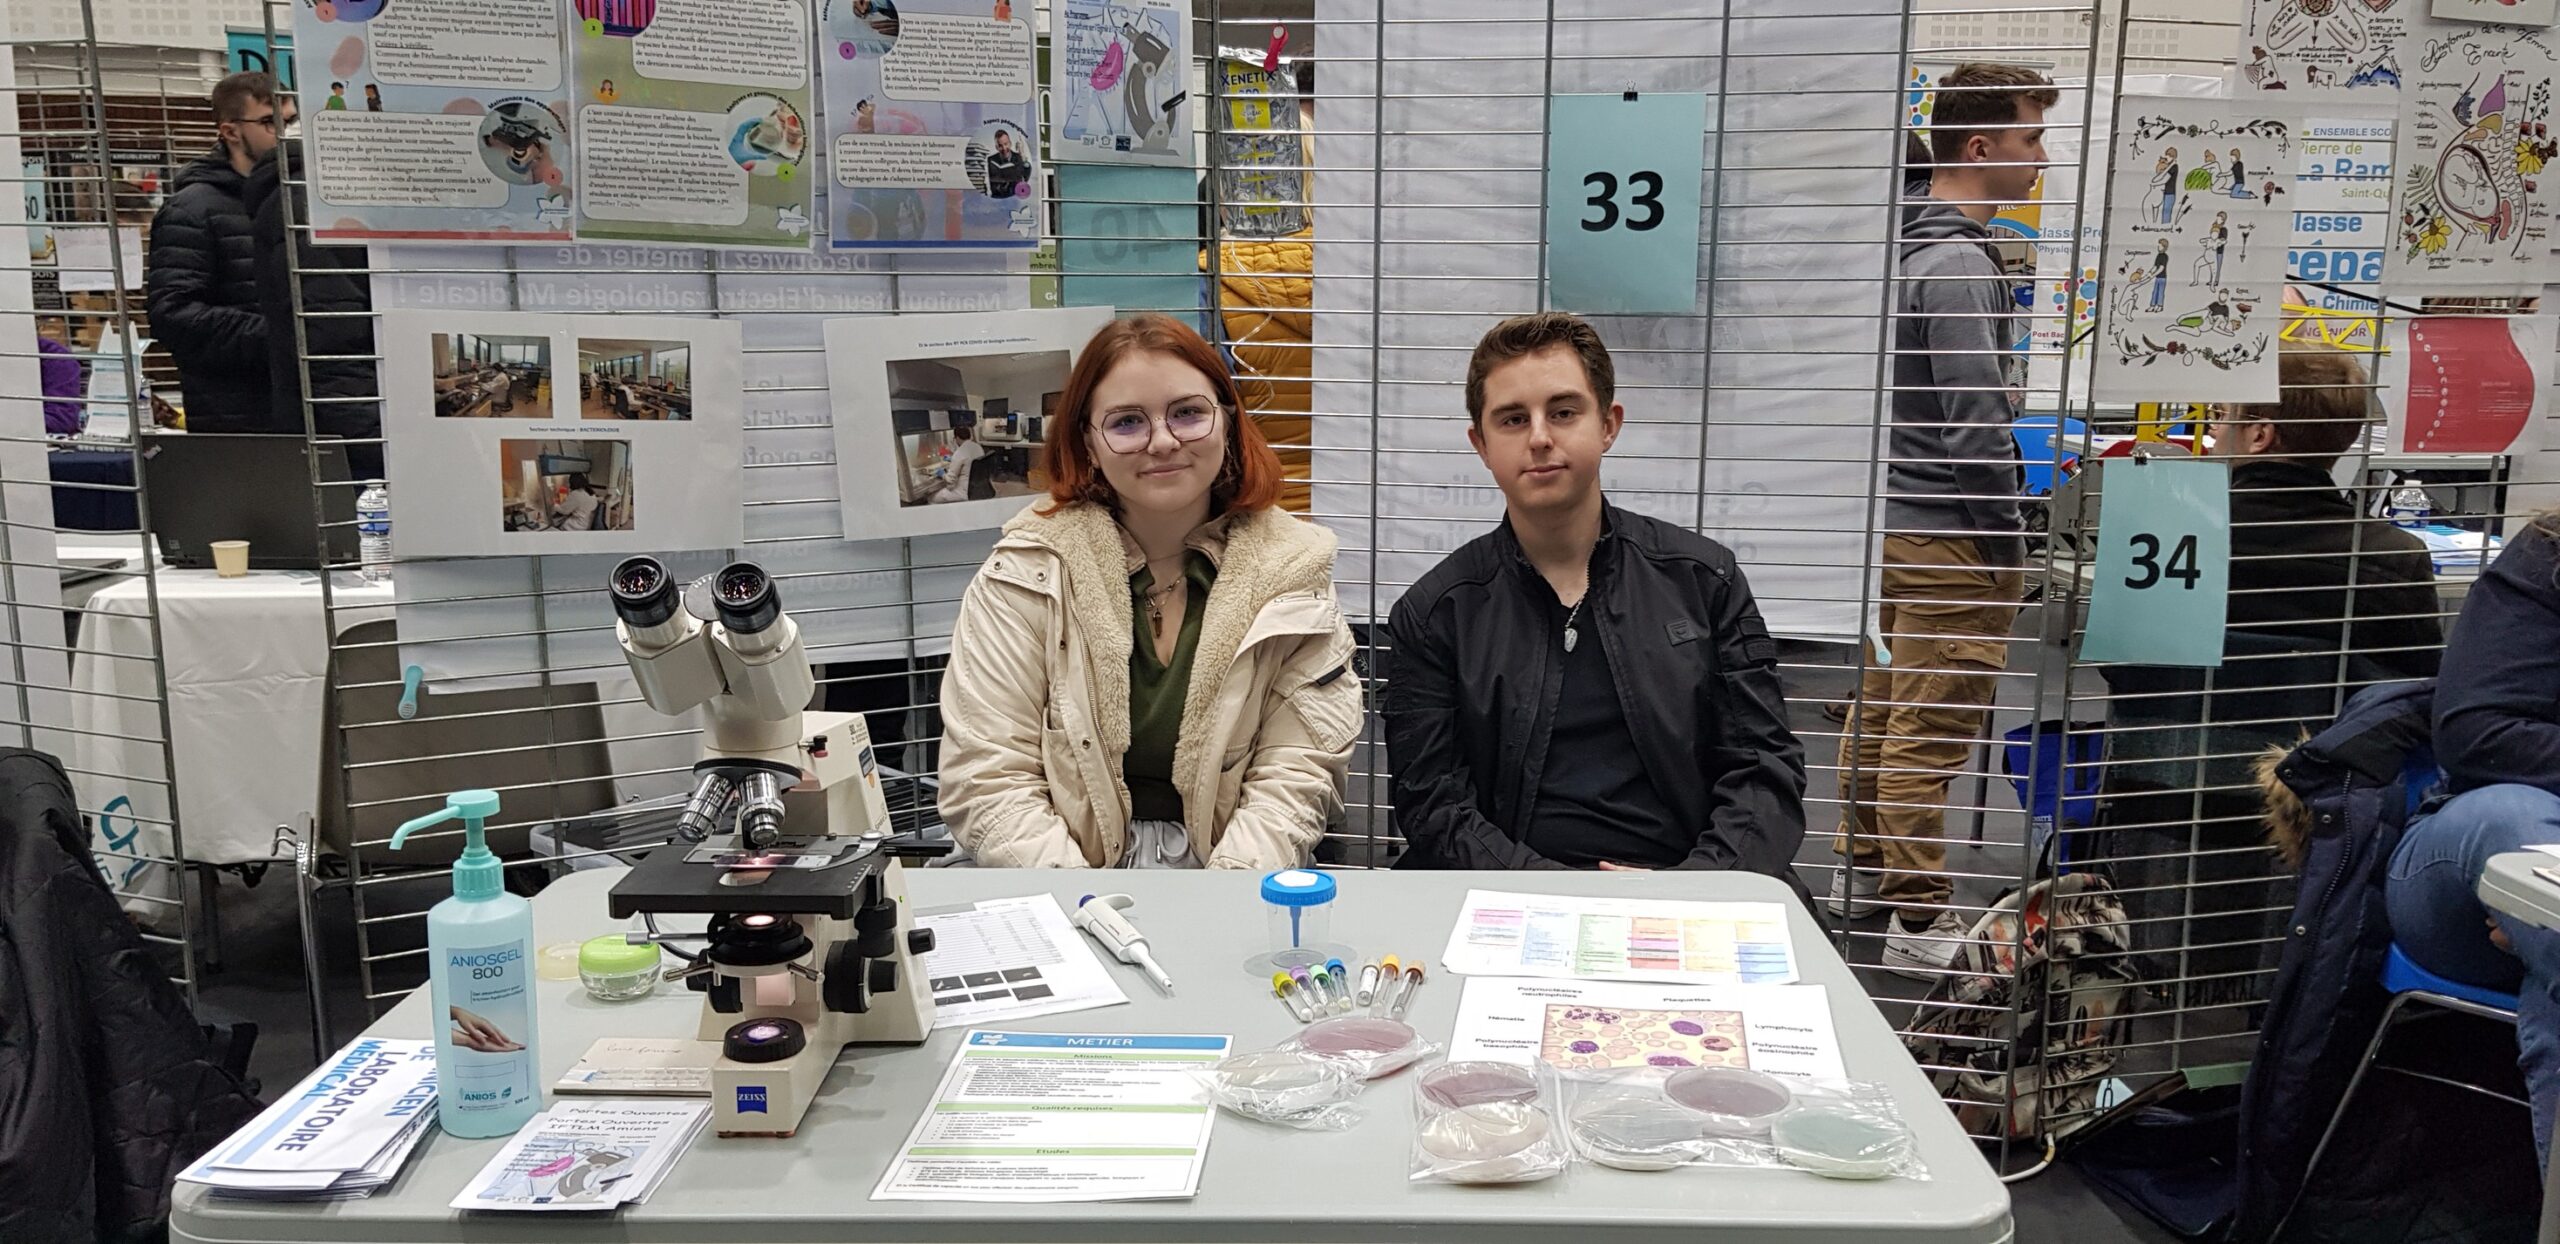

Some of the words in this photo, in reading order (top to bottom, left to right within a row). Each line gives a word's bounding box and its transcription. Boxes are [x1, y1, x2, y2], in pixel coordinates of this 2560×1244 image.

[1221, 71, 1276, 87] XENETIX
[2313, 128, 2368, 136] ENSEMBLE
[2345, 142, 2362, 154] de
[1581, 170, 1665, 232] 33
[2294, 212, 2362, 232] lasse
[2323, 295, 2380, 311] Chimie
[2124, 533, 2202, 591] 34
[450, 949, 522, 967] ANIOSGEL
[472, 966, 503, 980] 800
[1517, 986, 1583, 995] Polynucléaires
[1754, 1024, 1814, 1032] Lymphocyte
[1067, 1037, 1134, 1046] METIER
[1474, 1038, 1540, 1046] Polynucléaire
[1751, 1042, 1818, 1051] Polynucléaire
[274, 1052, 407, 1151] LABORATOIRE
[464, 1092, 496, 1101] ANIOS
